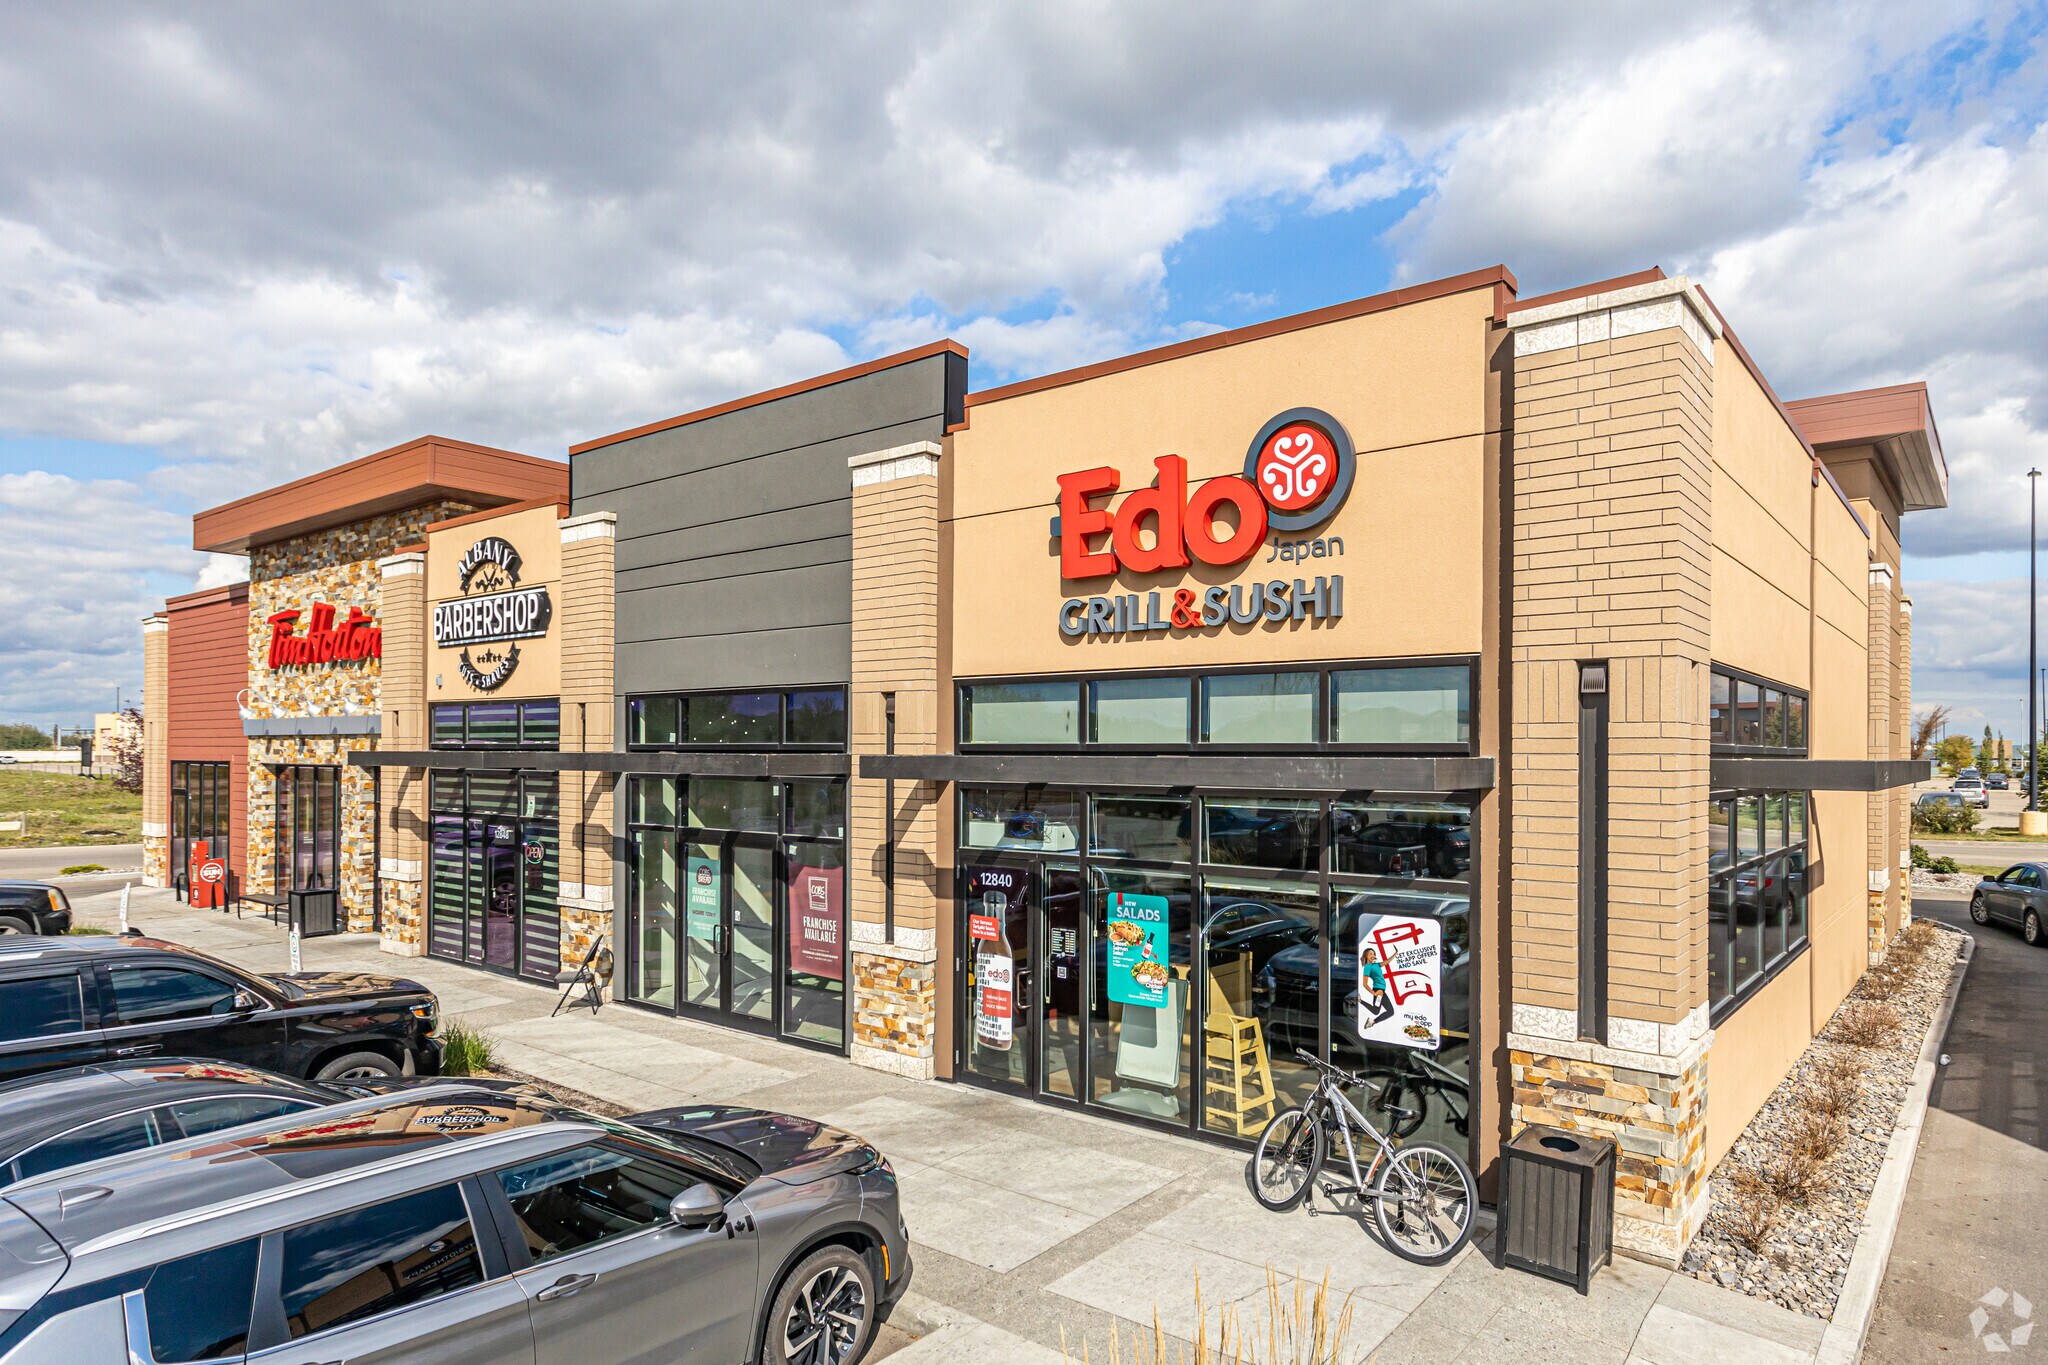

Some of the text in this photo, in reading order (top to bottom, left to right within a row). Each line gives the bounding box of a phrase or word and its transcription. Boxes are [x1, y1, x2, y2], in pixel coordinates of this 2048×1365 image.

[1057, 454, 1269, 579] Edo
[1267, 536, 1344, 565] Japan
[458, 539, 514, 580] ALBANY
[433, 593, 539, 641] BARBERSHOP
[307, 601, 382, 663] Horton
[458, 656, 509, 688] CUTS SHAVES
[525, 845, 543, 859] OPEN
[203, 869, 221, 877] SUN
[980, 872, 1013, 888] 12840
[692, 887, 716, 897] FRANCHISE
[811, 884, 825, 896] COBS
[692, 895, 716, 905] AVAILABLE
[1116, 906, 1161, 922] SALADS
[803, 916, 837, 932] FRANCHISE
[804, 927, 837, 944] AVAILABLE
[1397, 950, 1438, 964] IN-APP OFFERS
[1406, 945, 1437, 957] EXCLUSIVE
[1398, 962, 1412, 970] AND
[988, 969, 1003, 979] edo
[1420, 1020, 1433, 1028] app
